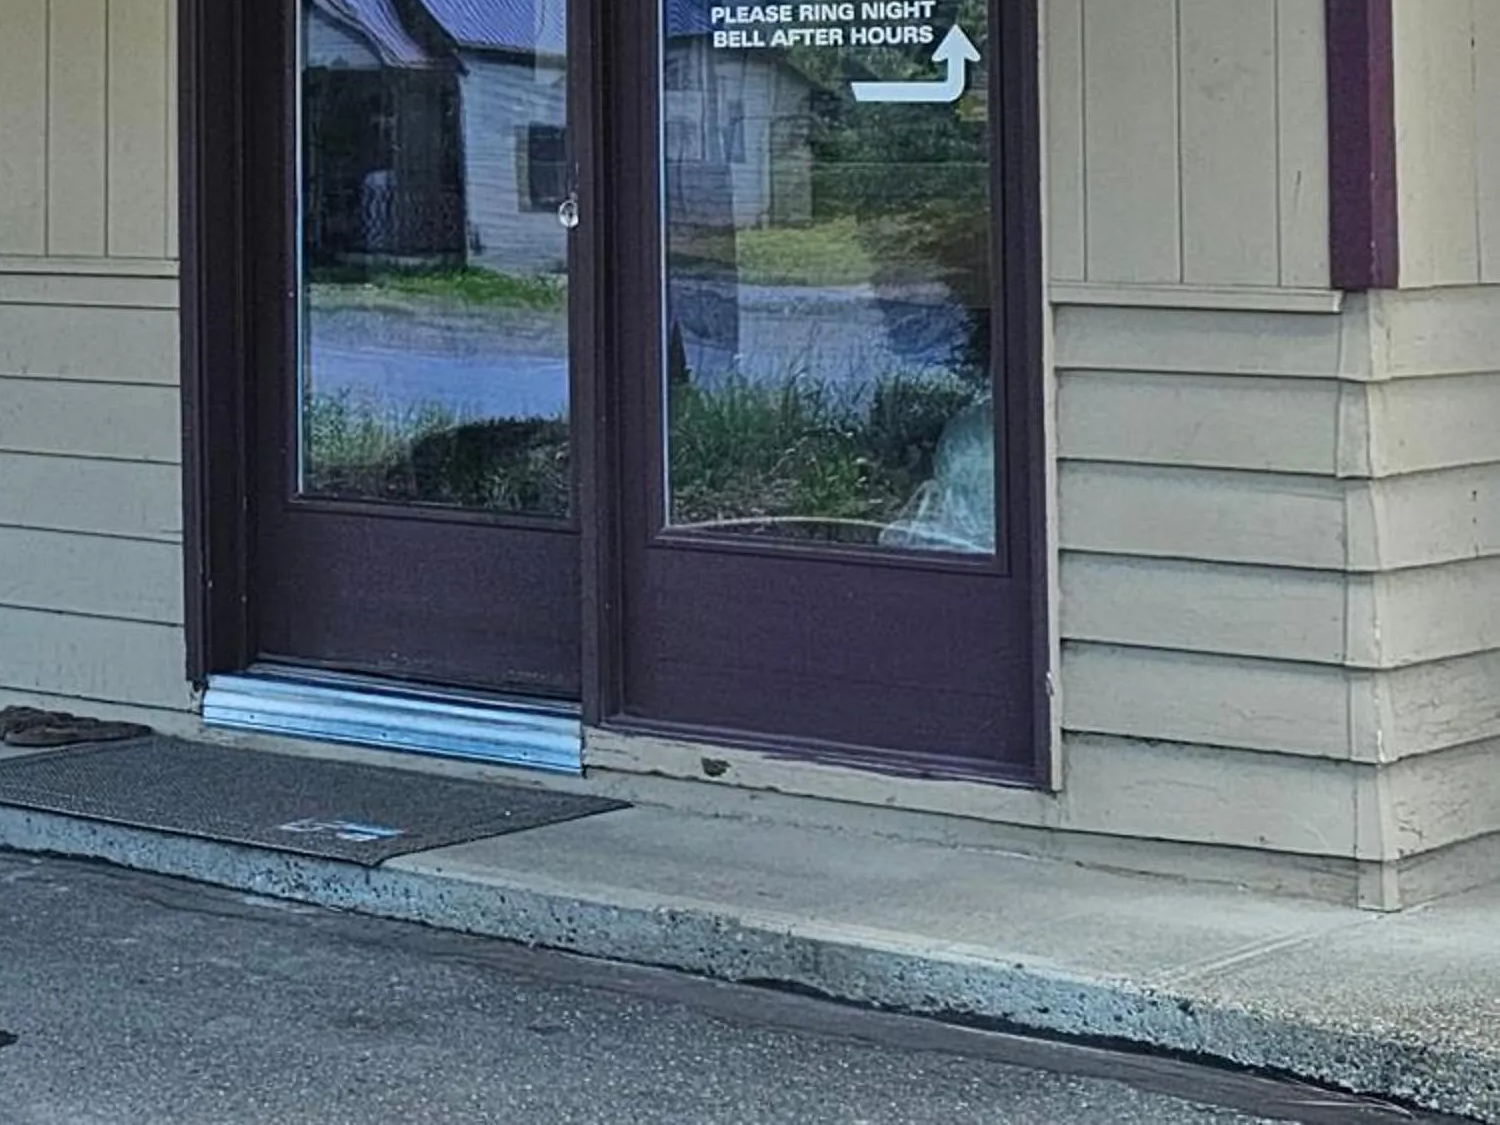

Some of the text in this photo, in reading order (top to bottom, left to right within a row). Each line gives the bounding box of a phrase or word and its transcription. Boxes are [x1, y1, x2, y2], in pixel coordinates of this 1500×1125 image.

[711, 0, 936, 24] PLEASE RING NIGHT
[713, 25, 934, 48] BELL AFTER HOURS
